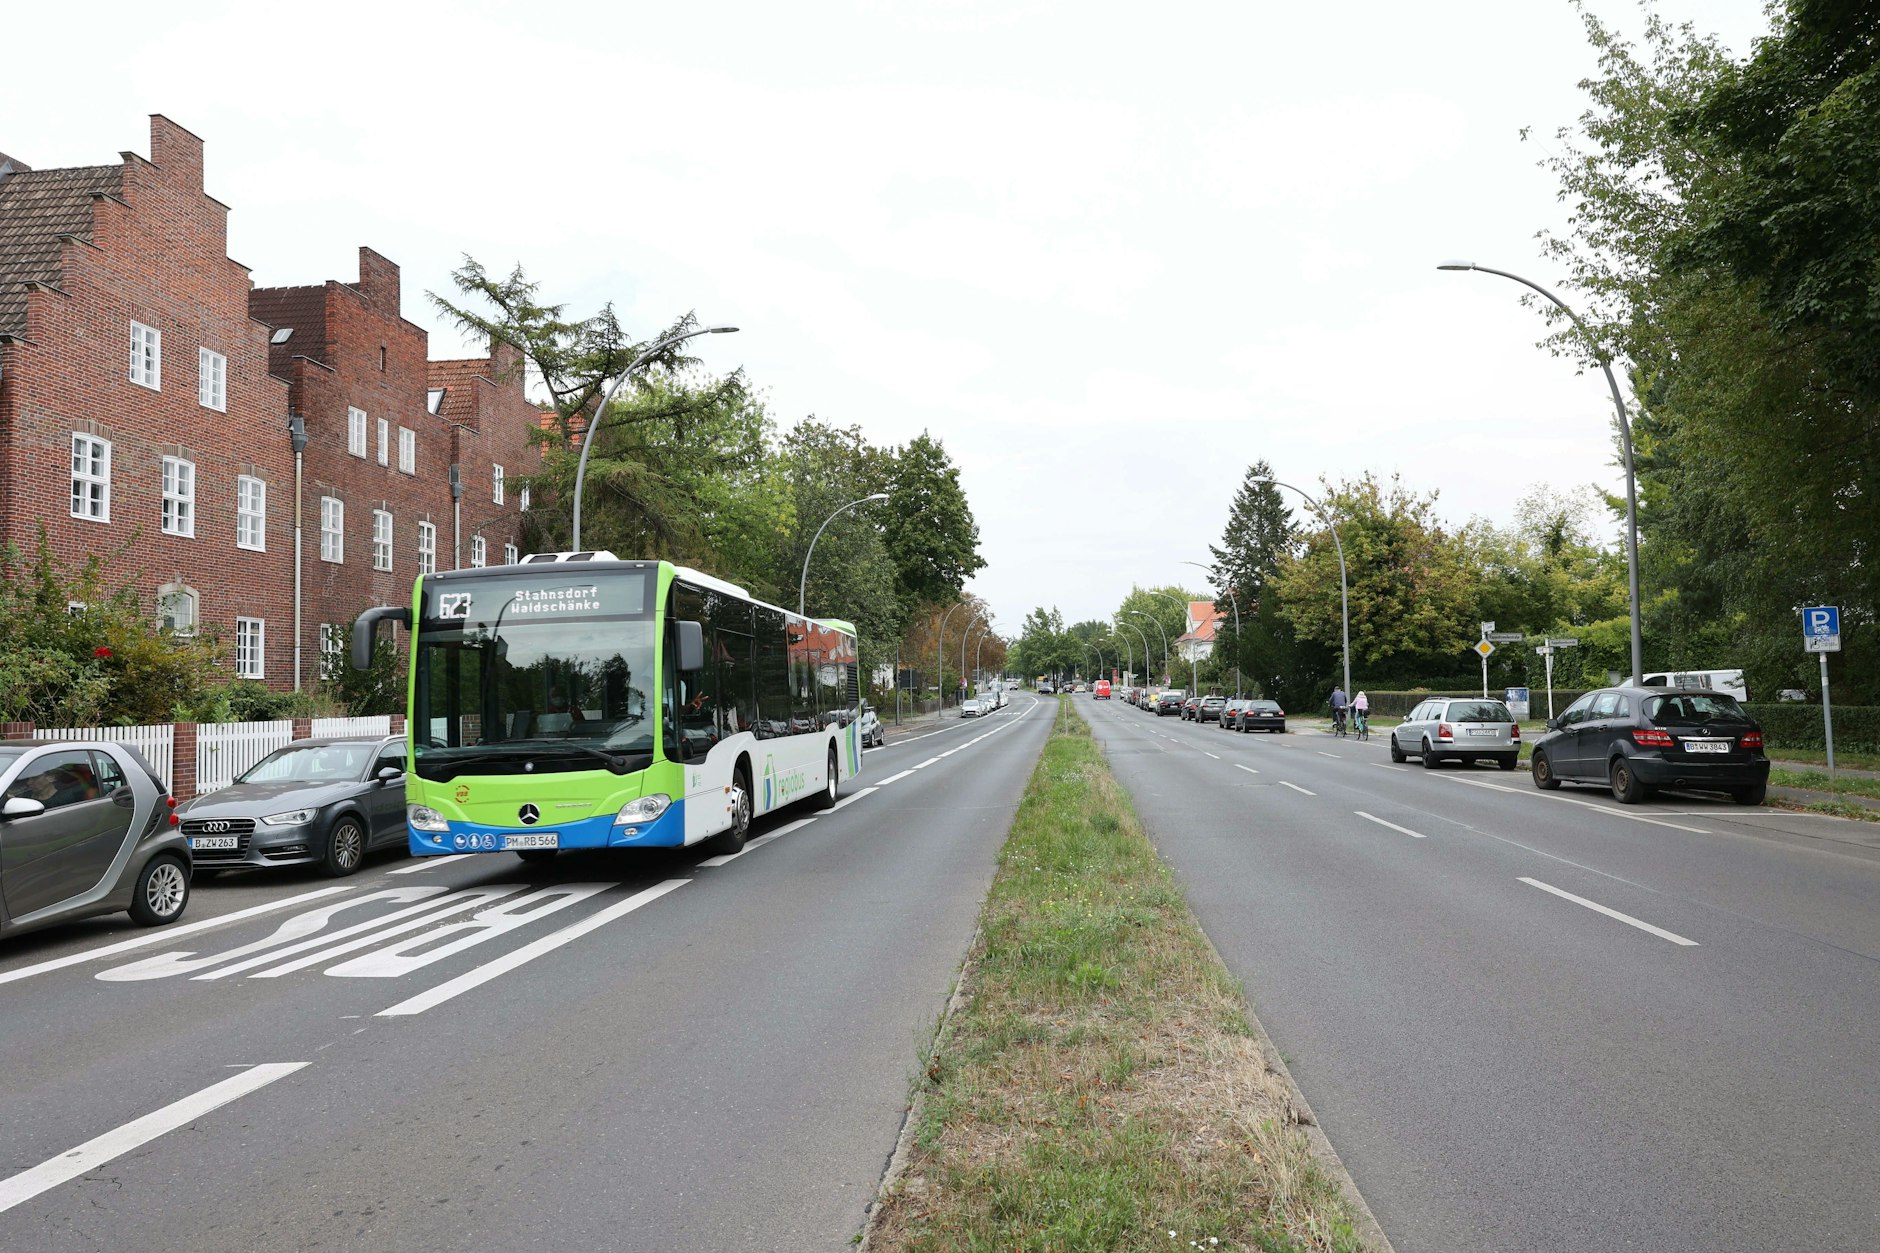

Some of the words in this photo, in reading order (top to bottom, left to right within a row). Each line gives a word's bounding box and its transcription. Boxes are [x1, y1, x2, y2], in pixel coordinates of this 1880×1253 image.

[515, 587, 598, 602] Stahnsdorf
[439, 592, 471, 619] 623
[511, 601, 600, 613] Waldschänke
[1811, 611, 1830, 628] P
[778, 773, 804, 801] regiobus
[195, 839, 201, 848] B
[206, 838, 217, 847] ZW
[218, 838, 234, 847] 263
[506, 837, 518, 846] PM
[524, 836, 537, 846] RB
[538, 836, 556, 846] 566
[94, 881, 623, 982] BUS
